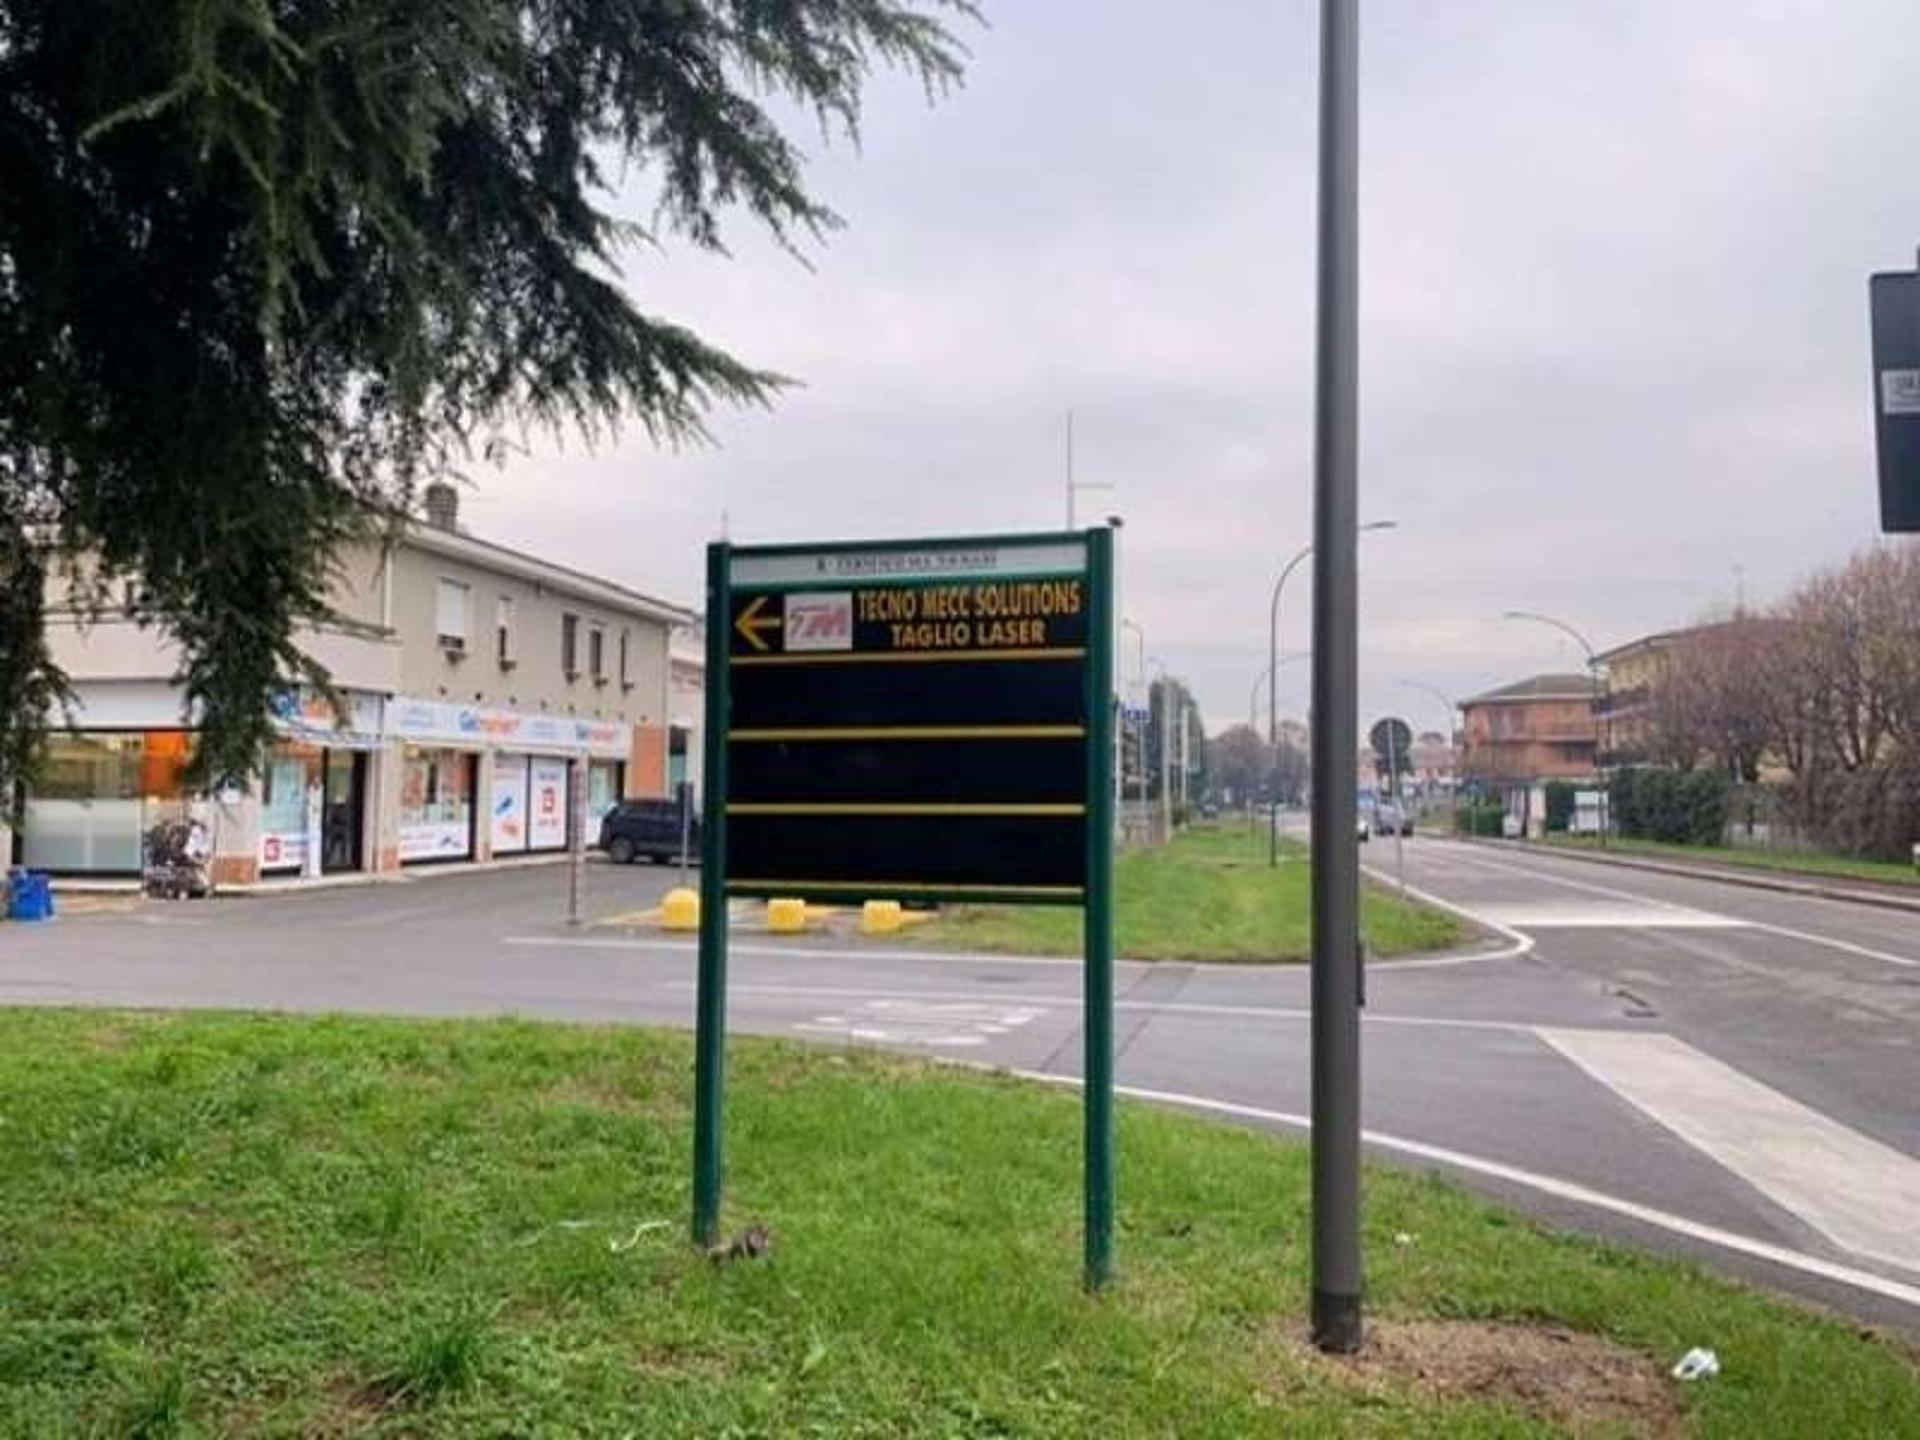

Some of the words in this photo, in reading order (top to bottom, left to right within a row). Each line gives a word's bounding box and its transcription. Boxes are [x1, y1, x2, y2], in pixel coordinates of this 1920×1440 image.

[858, 589, 916, 620] TECNO
[922, 586, 970, 618] MECC
[975, 581, 1082, 616] SOLUTIONS
[892, 622, 970, 647] TAGLIO
[978, 619, 1046, 646] LASER
